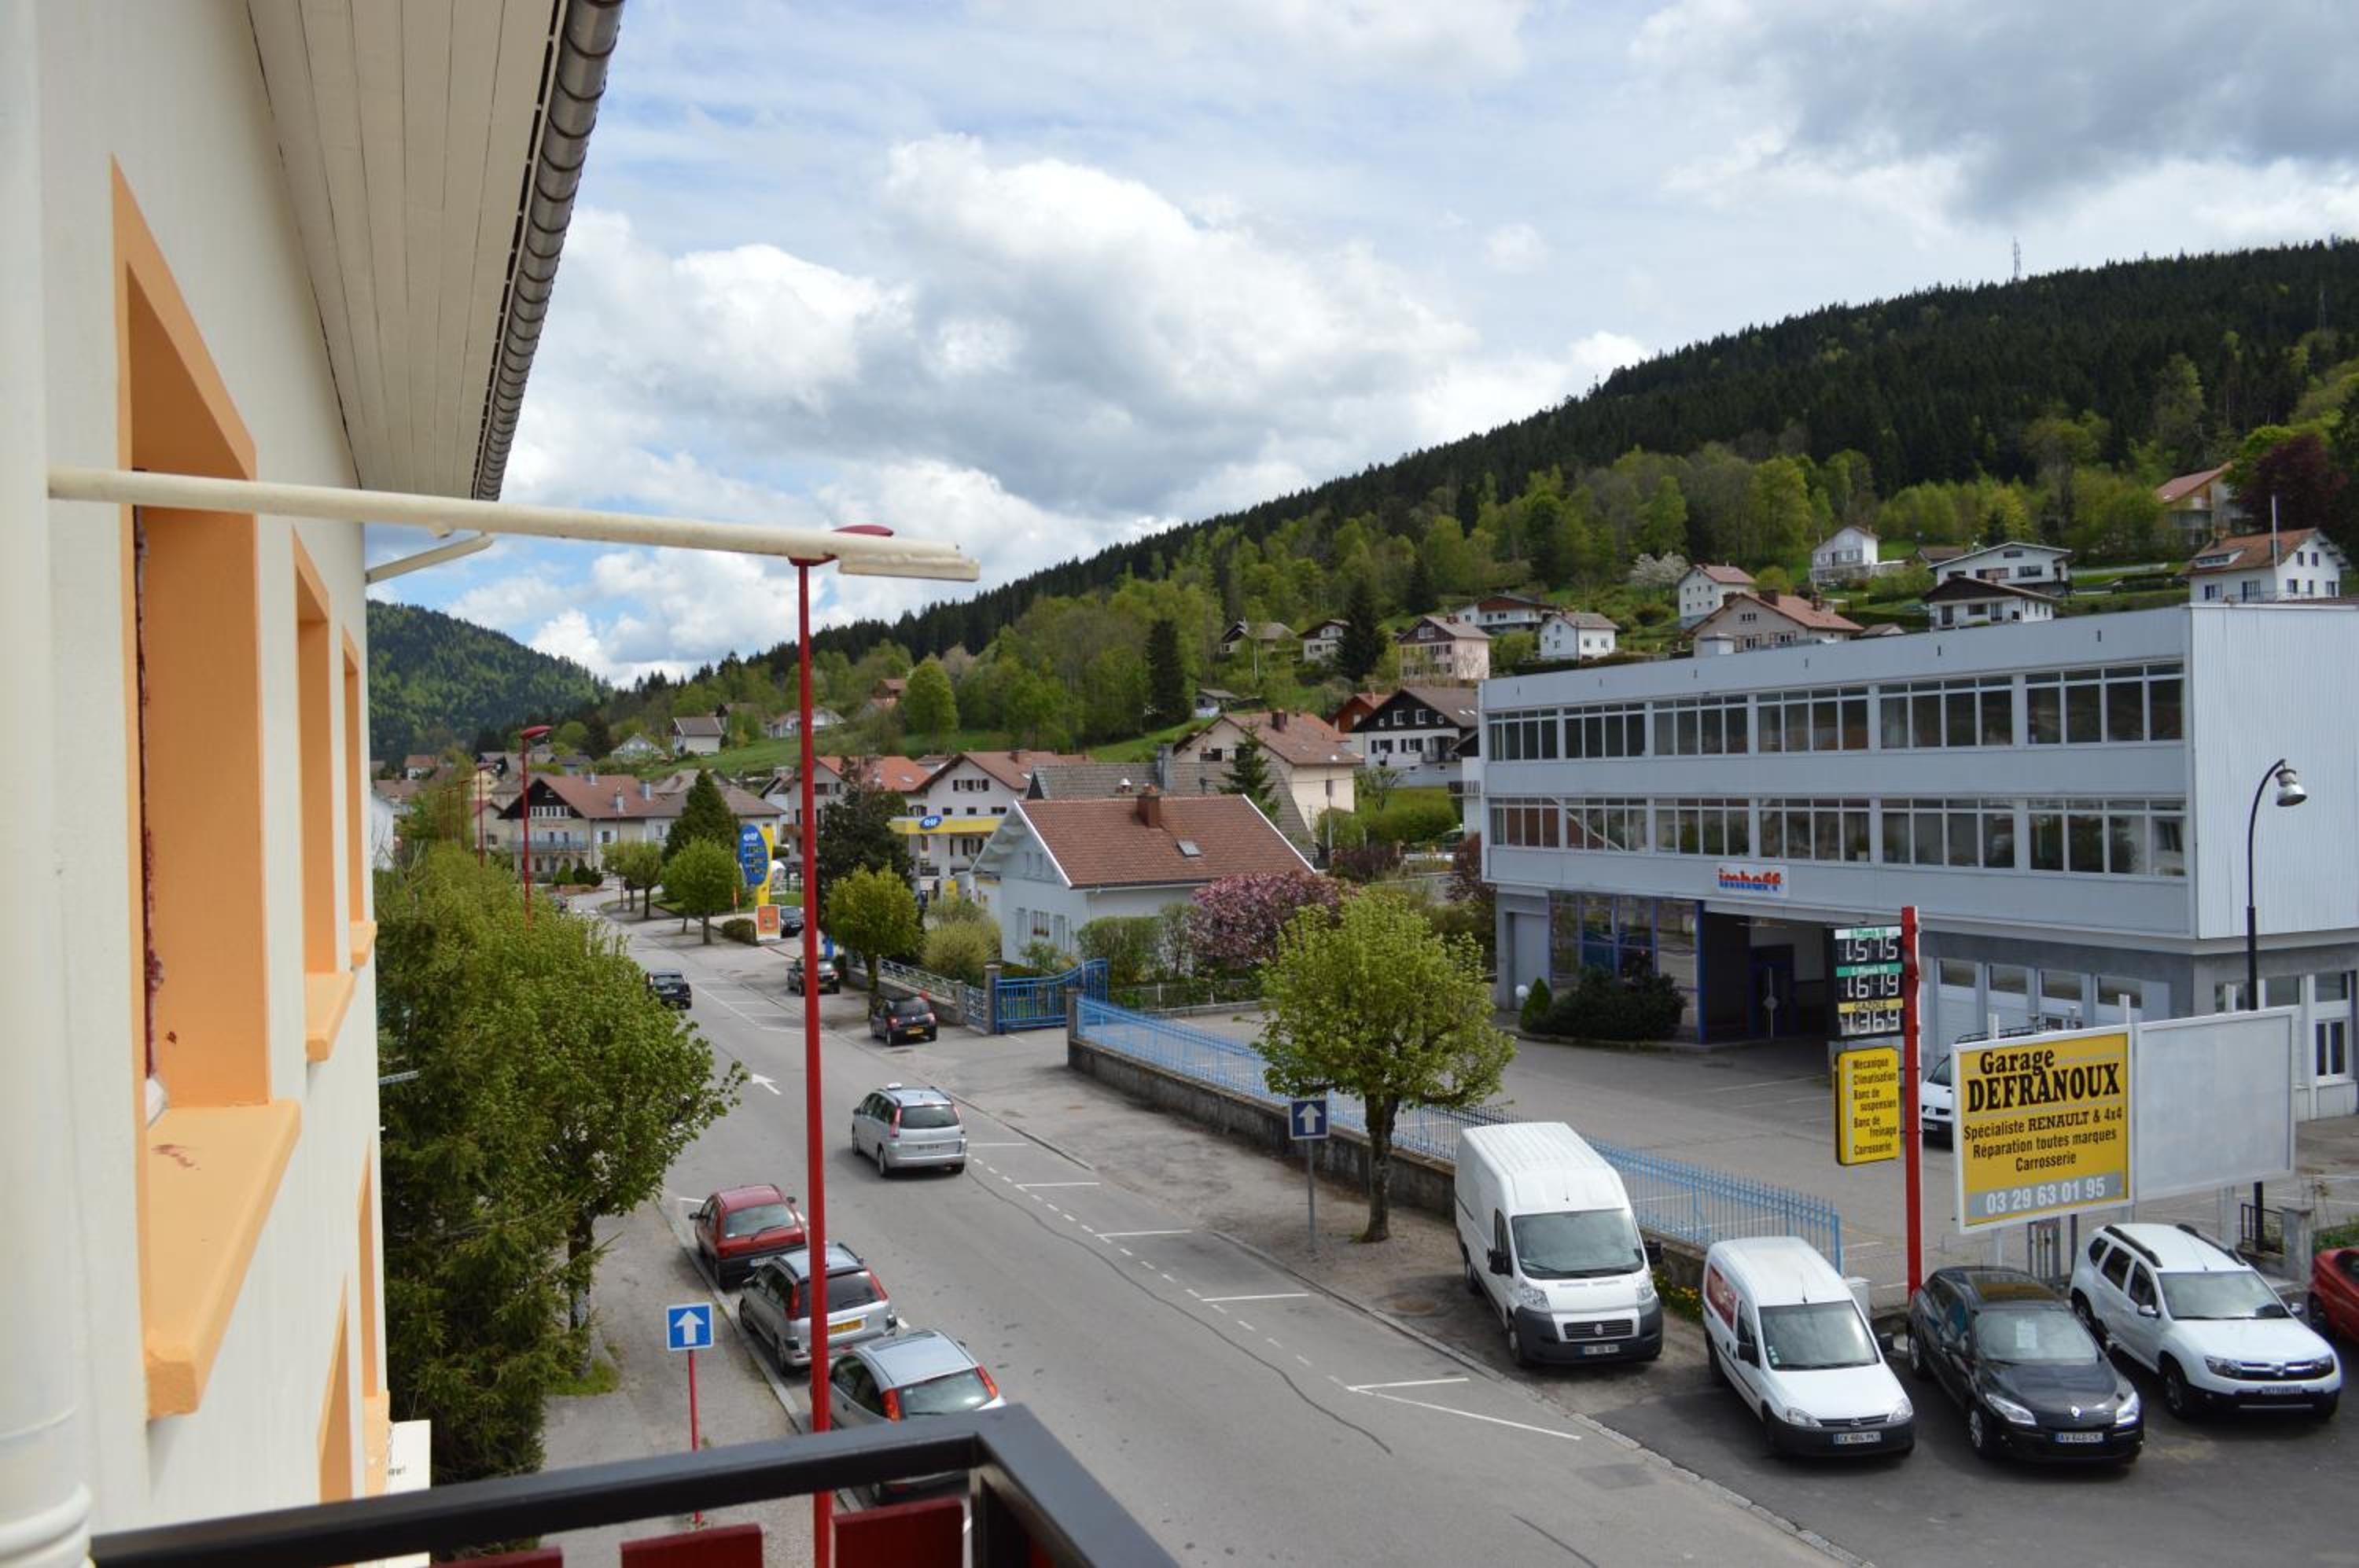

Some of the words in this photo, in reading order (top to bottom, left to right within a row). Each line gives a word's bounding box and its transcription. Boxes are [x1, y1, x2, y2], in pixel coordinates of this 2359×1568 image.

[1980, 1050, 2055, 1076] Garage
[1967, 1062, 2121, 1113] DEFRANOUX
[2028, 1112, 2089, 1132] RENAULT
[2092, 1107, 2101, 1123] &
[2104, 1106, 2122, 1121] 4x4
[2037, 1136, 2070, 1150] toutes
[2072, 1128, 2117, 1146] marques
[2015, 1151, 2077, 1172] Carrosserie
[1986, 1191, 2006, 1214] 03
[2012, 1188, 2031, 1210] 29
[2037, 1184, 2056, 1207] 63
[2061, 1180, 2080, 1204] 01
[2085, 1176, 2106, 1199] 95
